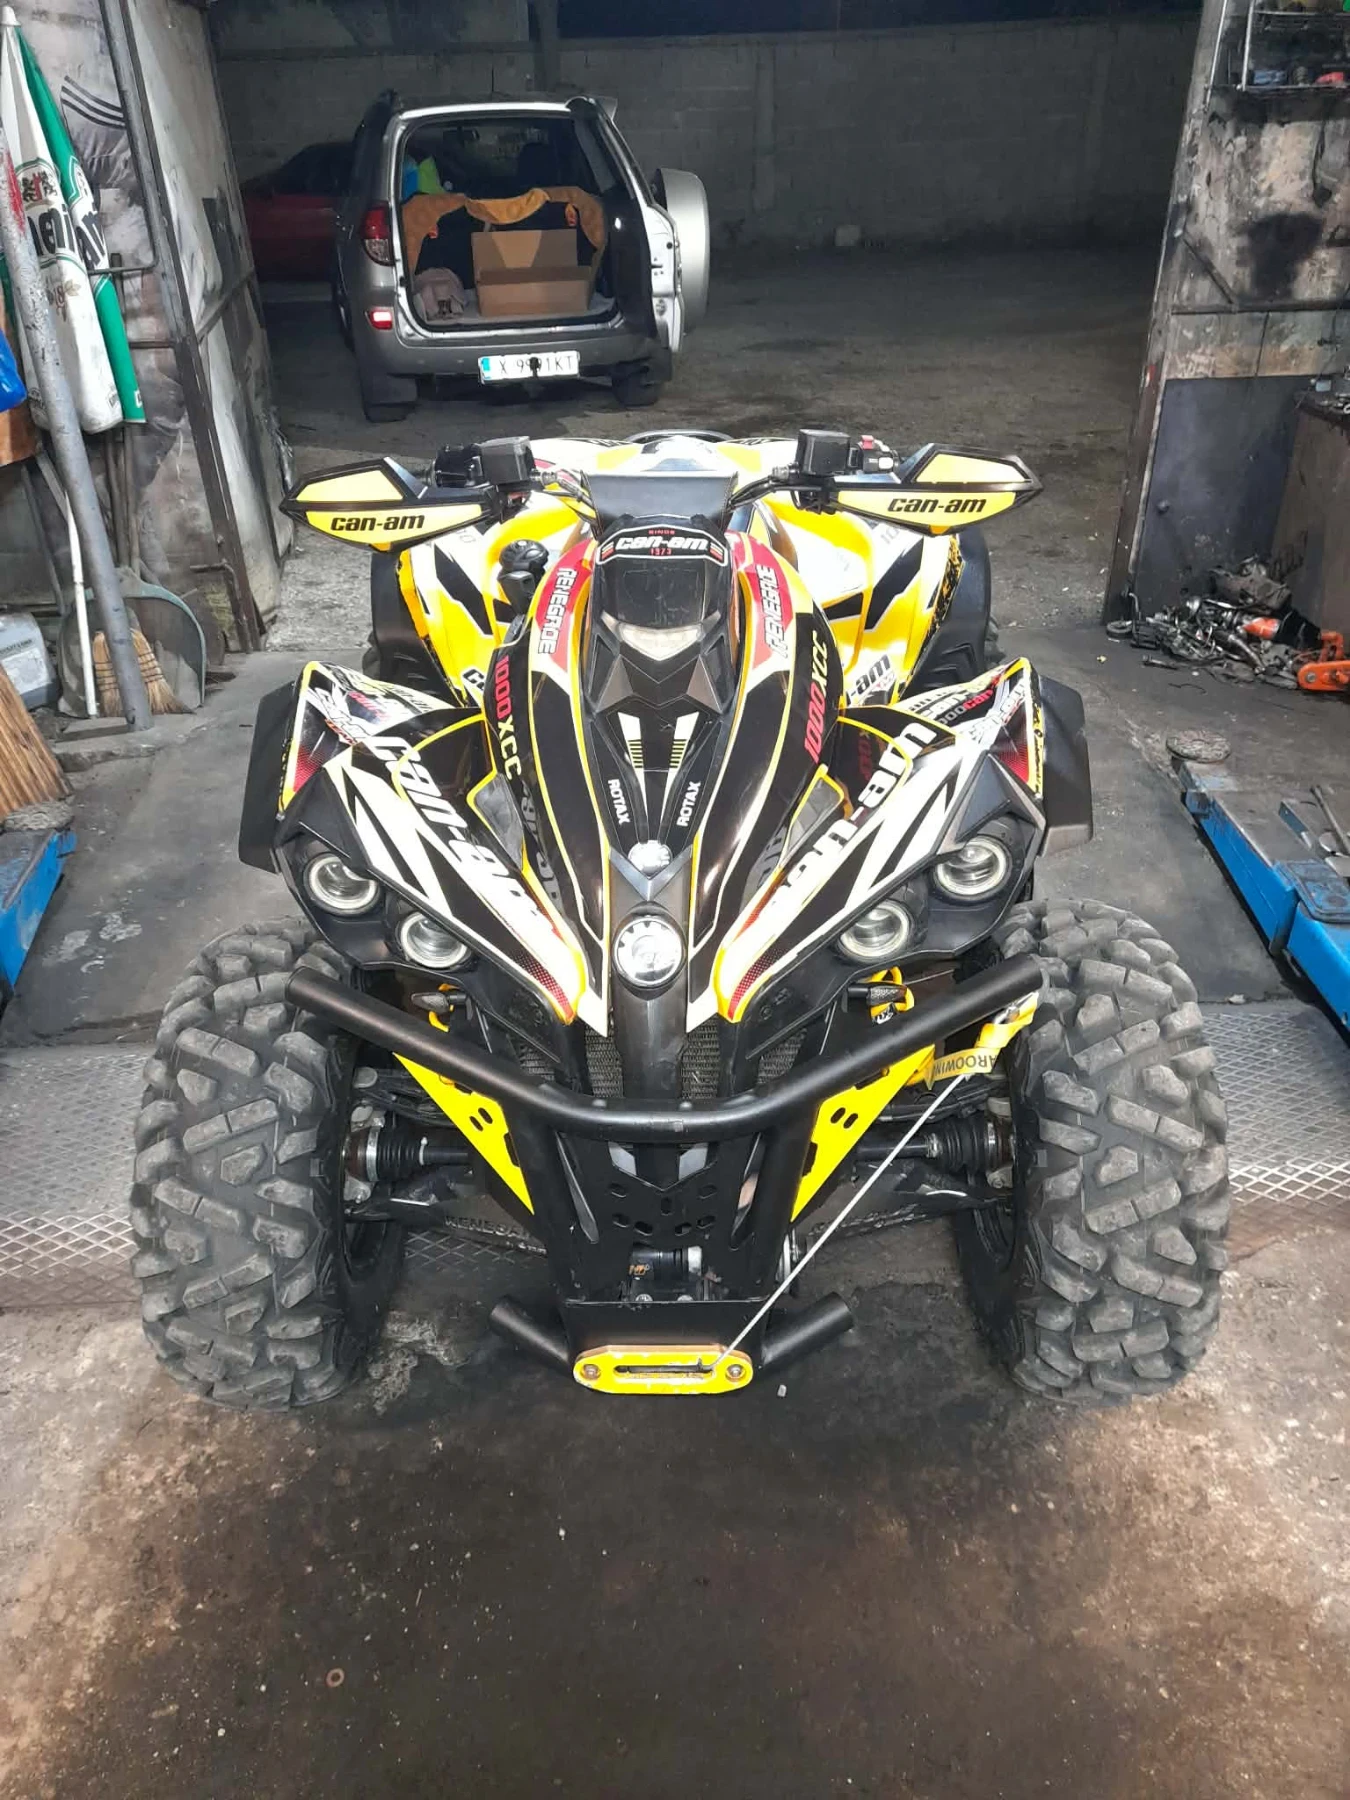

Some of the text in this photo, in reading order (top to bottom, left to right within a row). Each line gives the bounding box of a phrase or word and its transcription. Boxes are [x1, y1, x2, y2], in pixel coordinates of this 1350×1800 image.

[887, 497, 987, 514] can-am
[330, 514, 425, 532] can-am
[615, 536, 709, 550] can-am
[538, 567, 577, 655] RENEGADE
[608, 779, 631, 825] ROTAX
[677, 781, 701, 827] ROTAX
